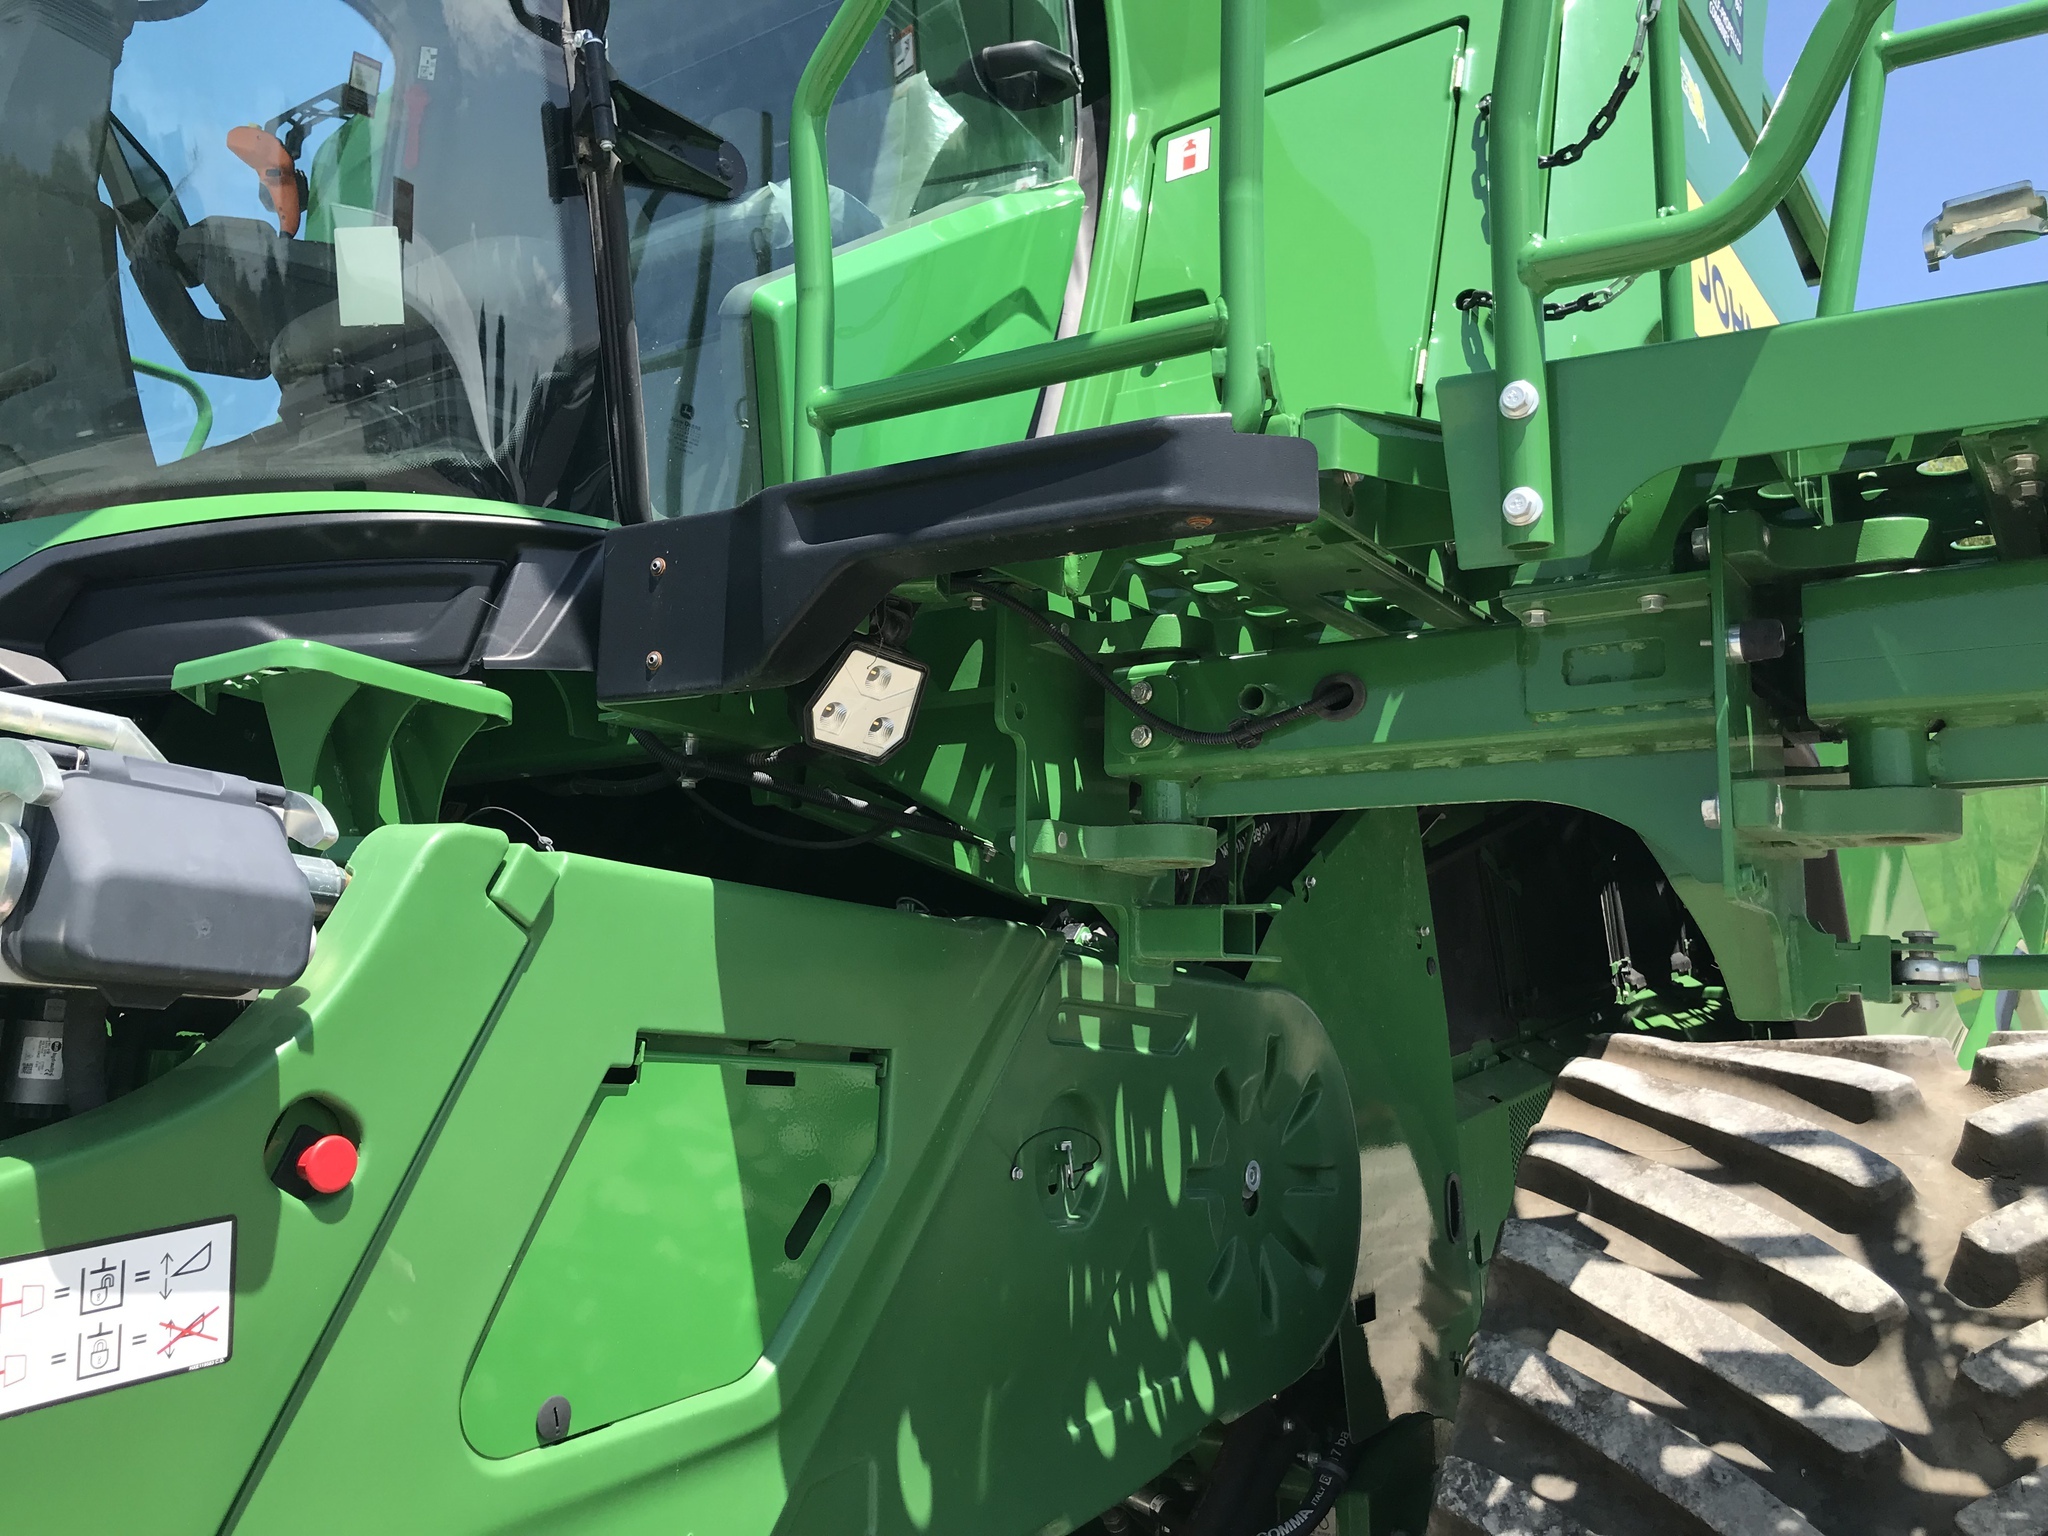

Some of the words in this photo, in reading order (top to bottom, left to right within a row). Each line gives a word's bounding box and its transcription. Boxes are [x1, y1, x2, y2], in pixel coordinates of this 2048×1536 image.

[1698, 256, 1751, 332] JOH
[1335, 1431, 1349, 1447] ba
[1311, 1486, 1326, 1506] ITALY
